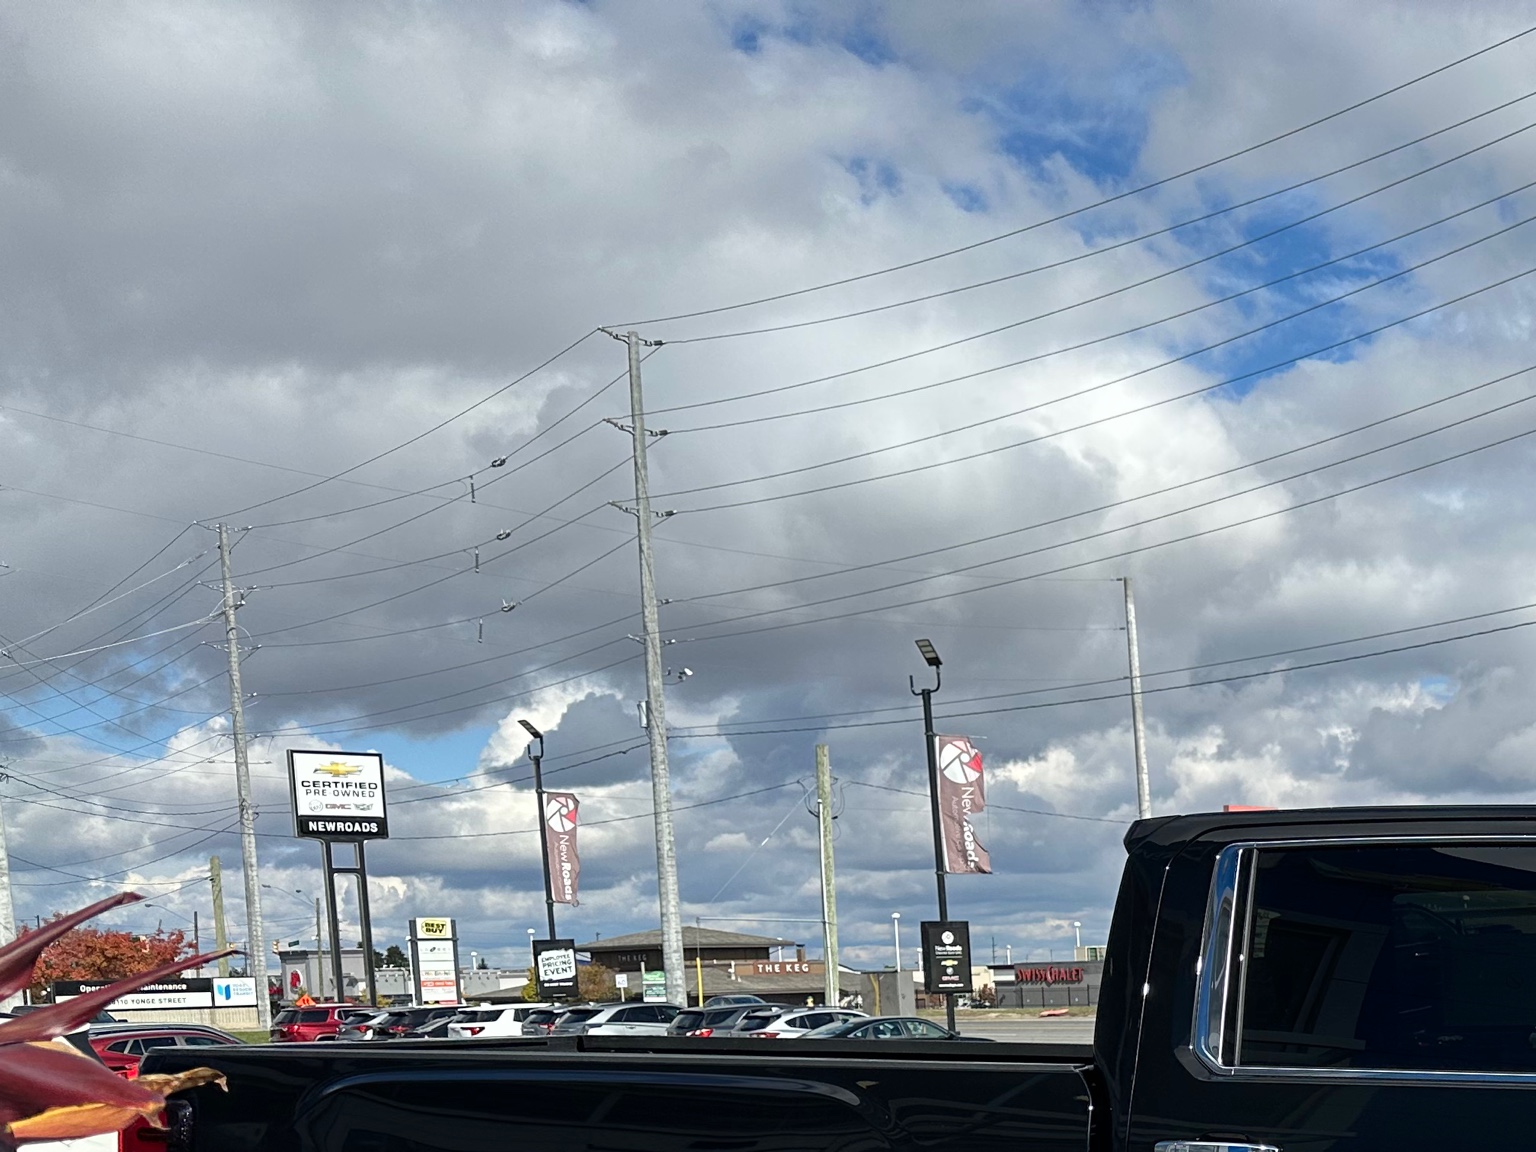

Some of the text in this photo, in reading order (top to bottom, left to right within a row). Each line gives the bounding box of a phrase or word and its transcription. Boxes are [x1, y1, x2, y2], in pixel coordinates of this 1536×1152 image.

[301, 781, 378, 789] CERTIFIED
[306, 789, 375, 797] PRE-OWNED
[308, 821, 378, 833] NEWROADS
[559, 834, 573, 900] NewRoads
[542, 959, 572, 968] PRICING
[544, 966, 572, 976] EVENT
[757, 964, 809, 973] THE KEG
[1017, 965, 1084, 983] SWISS CHALET
[138, 983, 187, 991] aintenance
